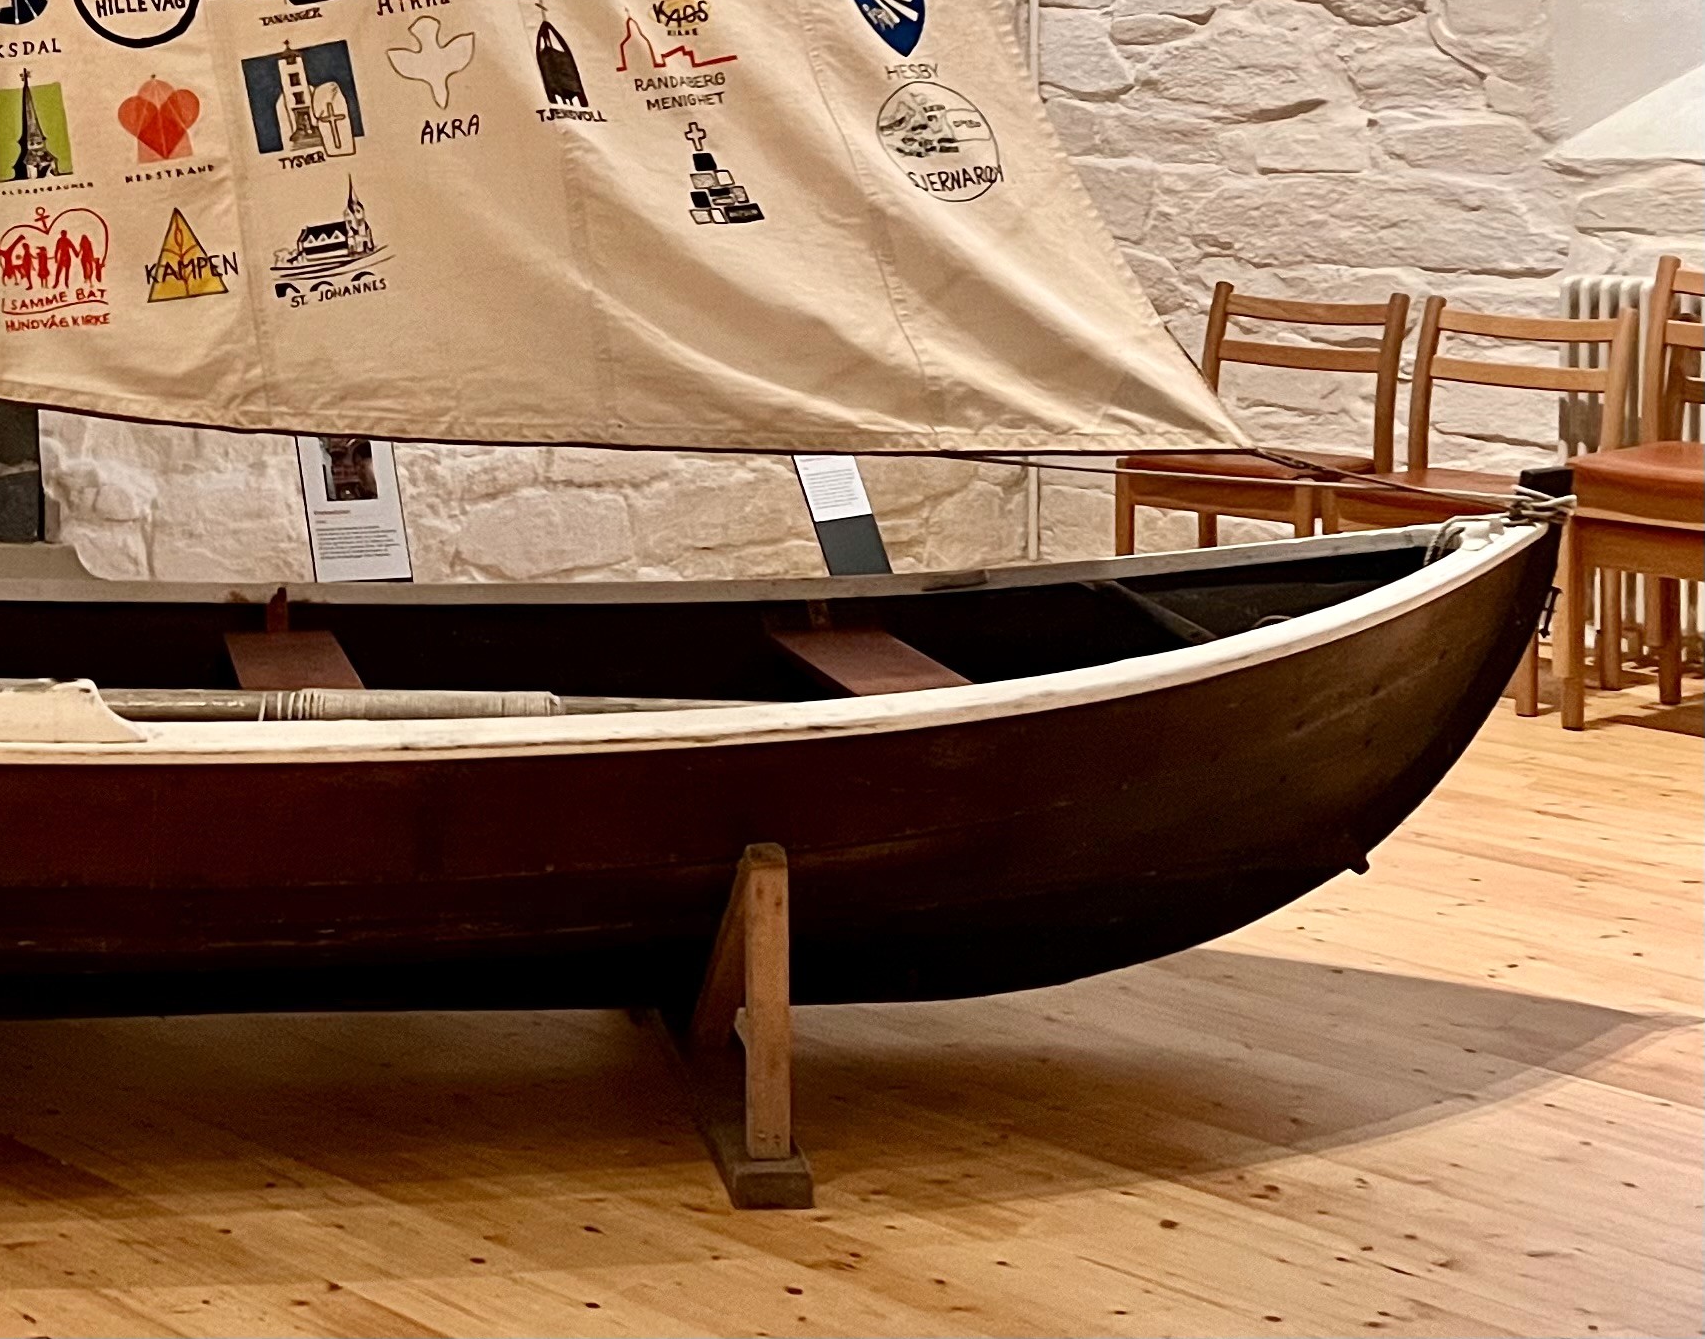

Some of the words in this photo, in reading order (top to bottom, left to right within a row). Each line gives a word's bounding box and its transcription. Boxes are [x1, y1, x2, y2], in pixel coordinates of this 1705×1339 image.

[259, 7, 322, 26] TANANGER
[884, 63, 939, 80] HESBY
[634, 72, 726, 92] RANDABERG
[646, 91, 725, 111] MENIGHET
[278, 150, 326, 170] TYSVÆR
[125, 164, 215, 183] NEDSTRAND
[907, 164, 1004, 192] SJERNARØY
[144, 254, 238, 285] KAMPEN
[318, 278, 386, 302] JOHANNES
[10, 291, 68, 310] SAMME
[5, 314, 69, 332] HUNDVÅG
[72, 312, 110, 327] KIRKE
